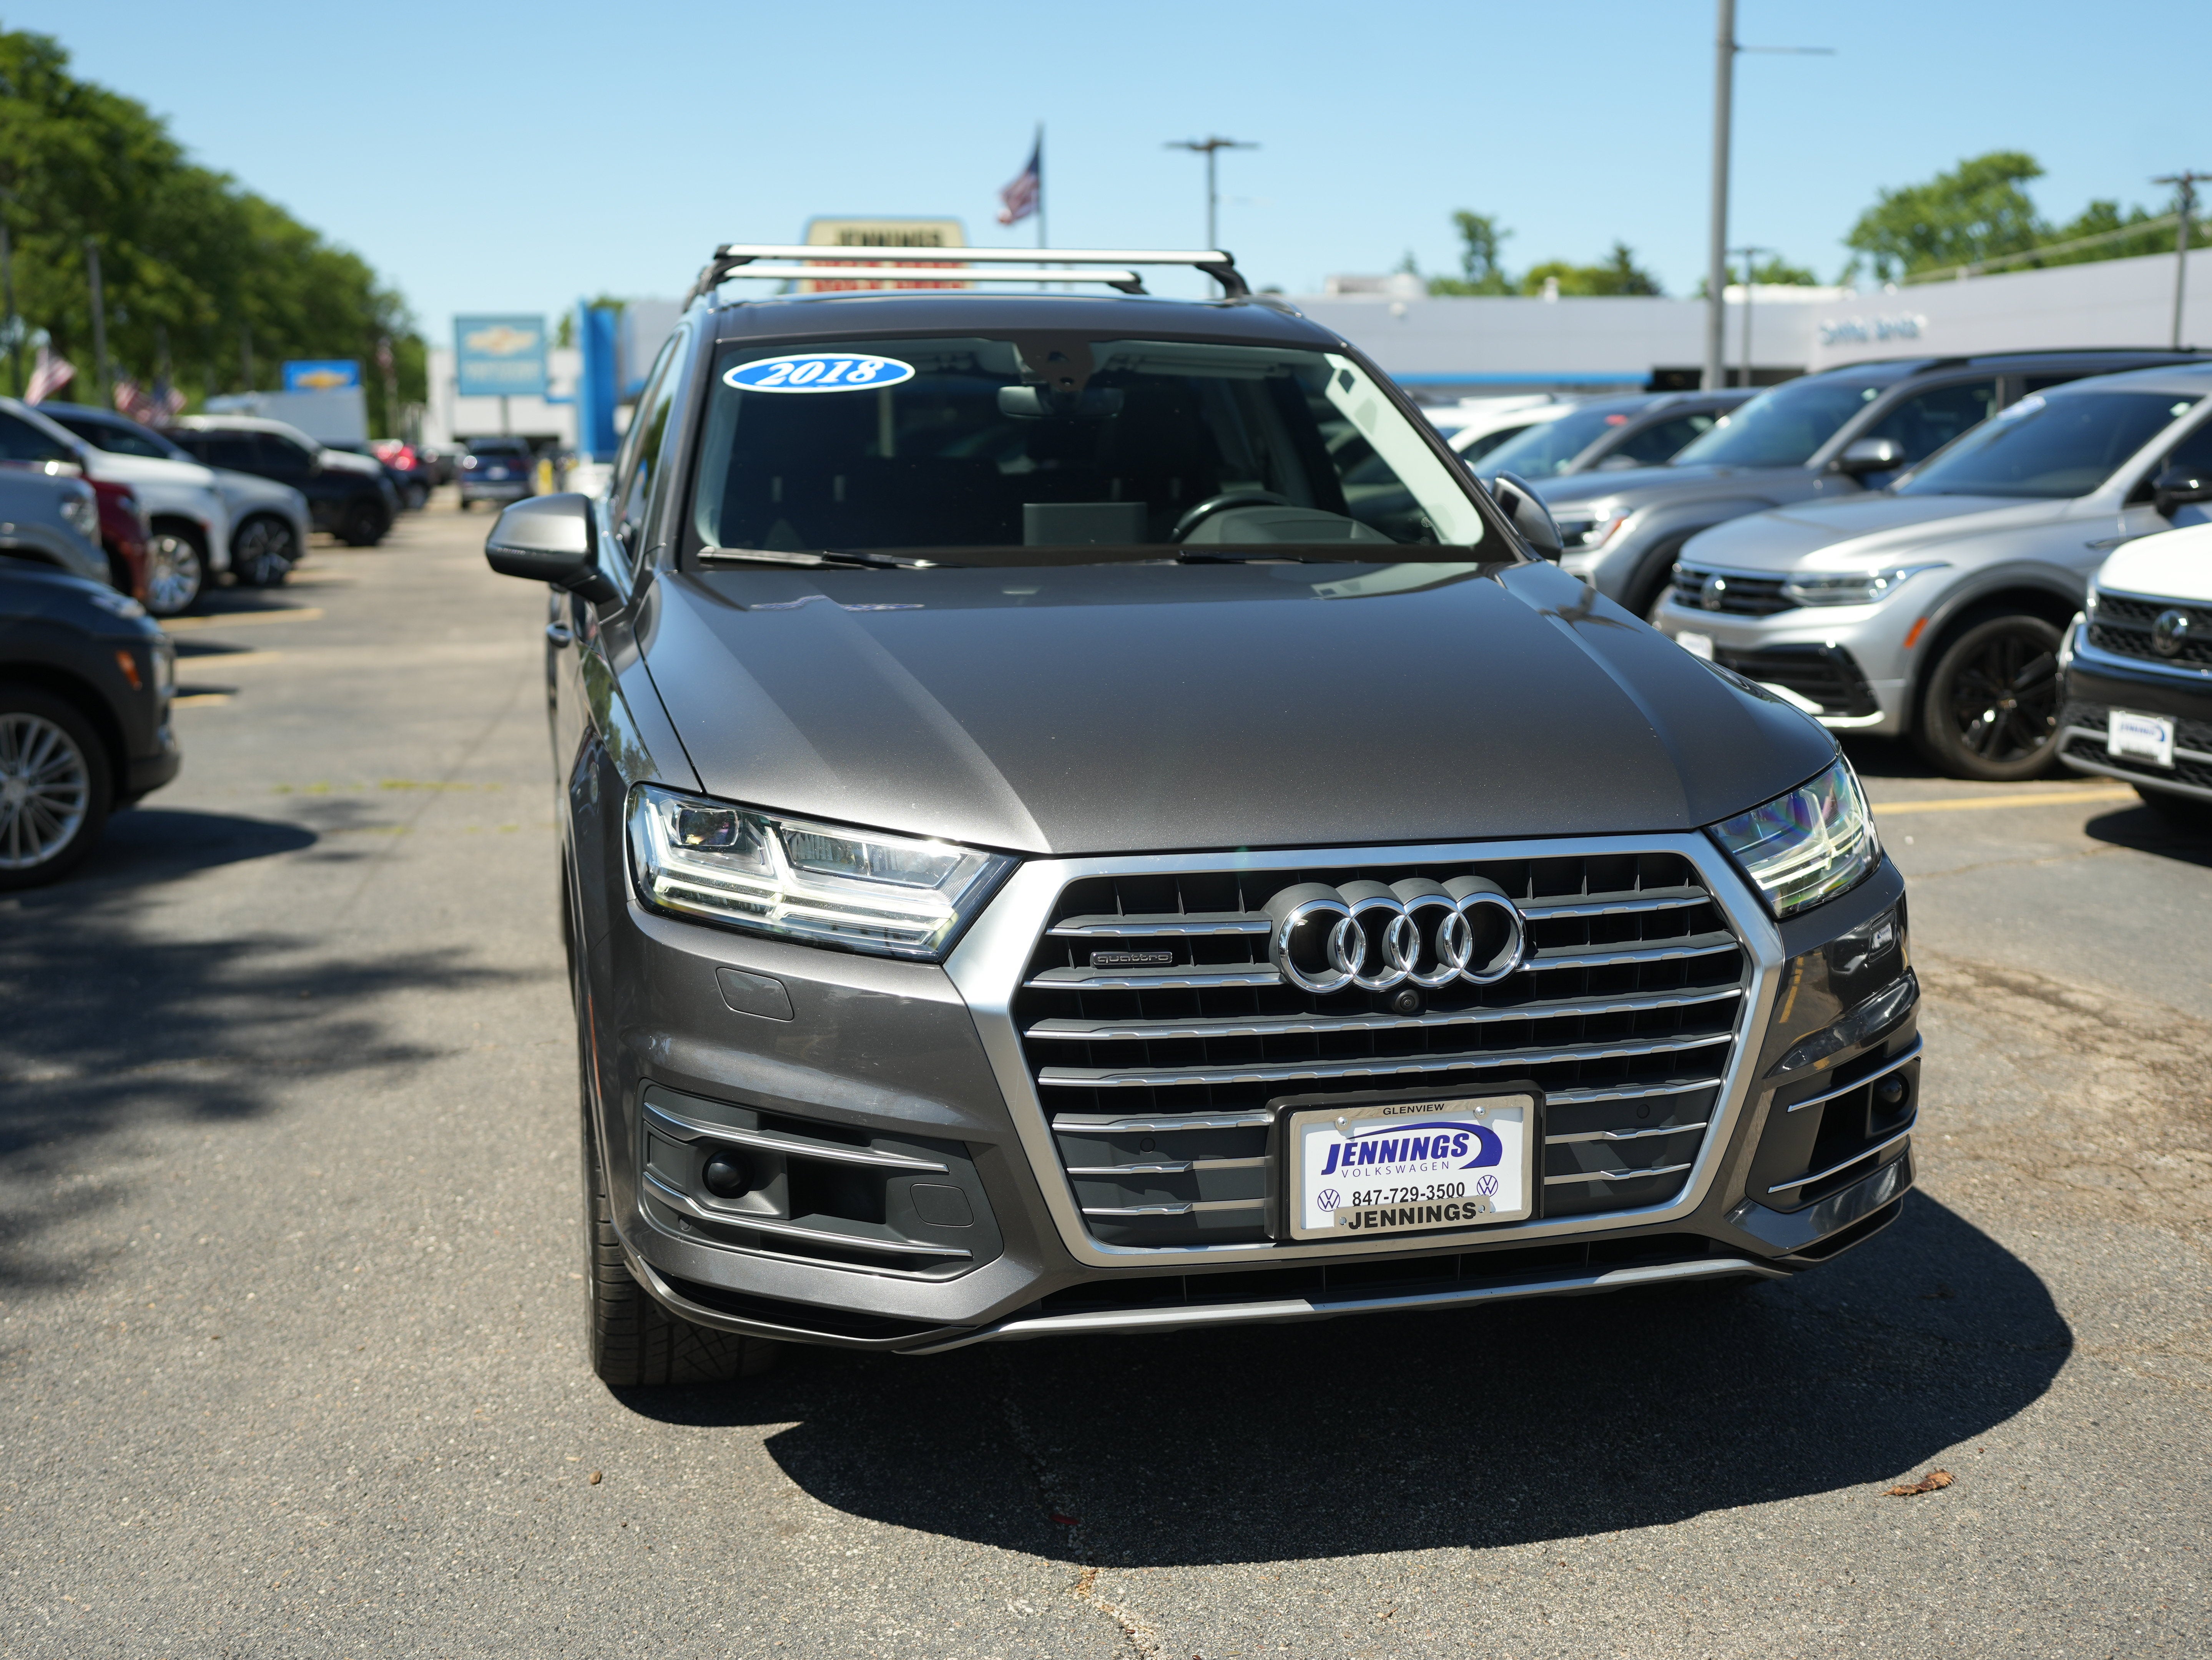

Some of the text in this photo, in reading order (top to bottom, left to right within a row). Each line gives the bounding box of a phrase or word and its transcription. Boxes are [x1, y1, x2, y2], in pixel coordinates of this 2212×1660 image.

[754, 360, 885, 386] 2018
[1097, 954, 1169, 963] quattro
[1383, 1104, 1445, 1115] GLENVIEW
[1321, 1132, 1469, 1175] JENNINGS
[1341, 1161, 1449, 1178] VOLKSWAGEN
[1352, 1182, 1465, 1207] 847-729-3500
[1348, 1202, 1477, 1230] JENNINGS
